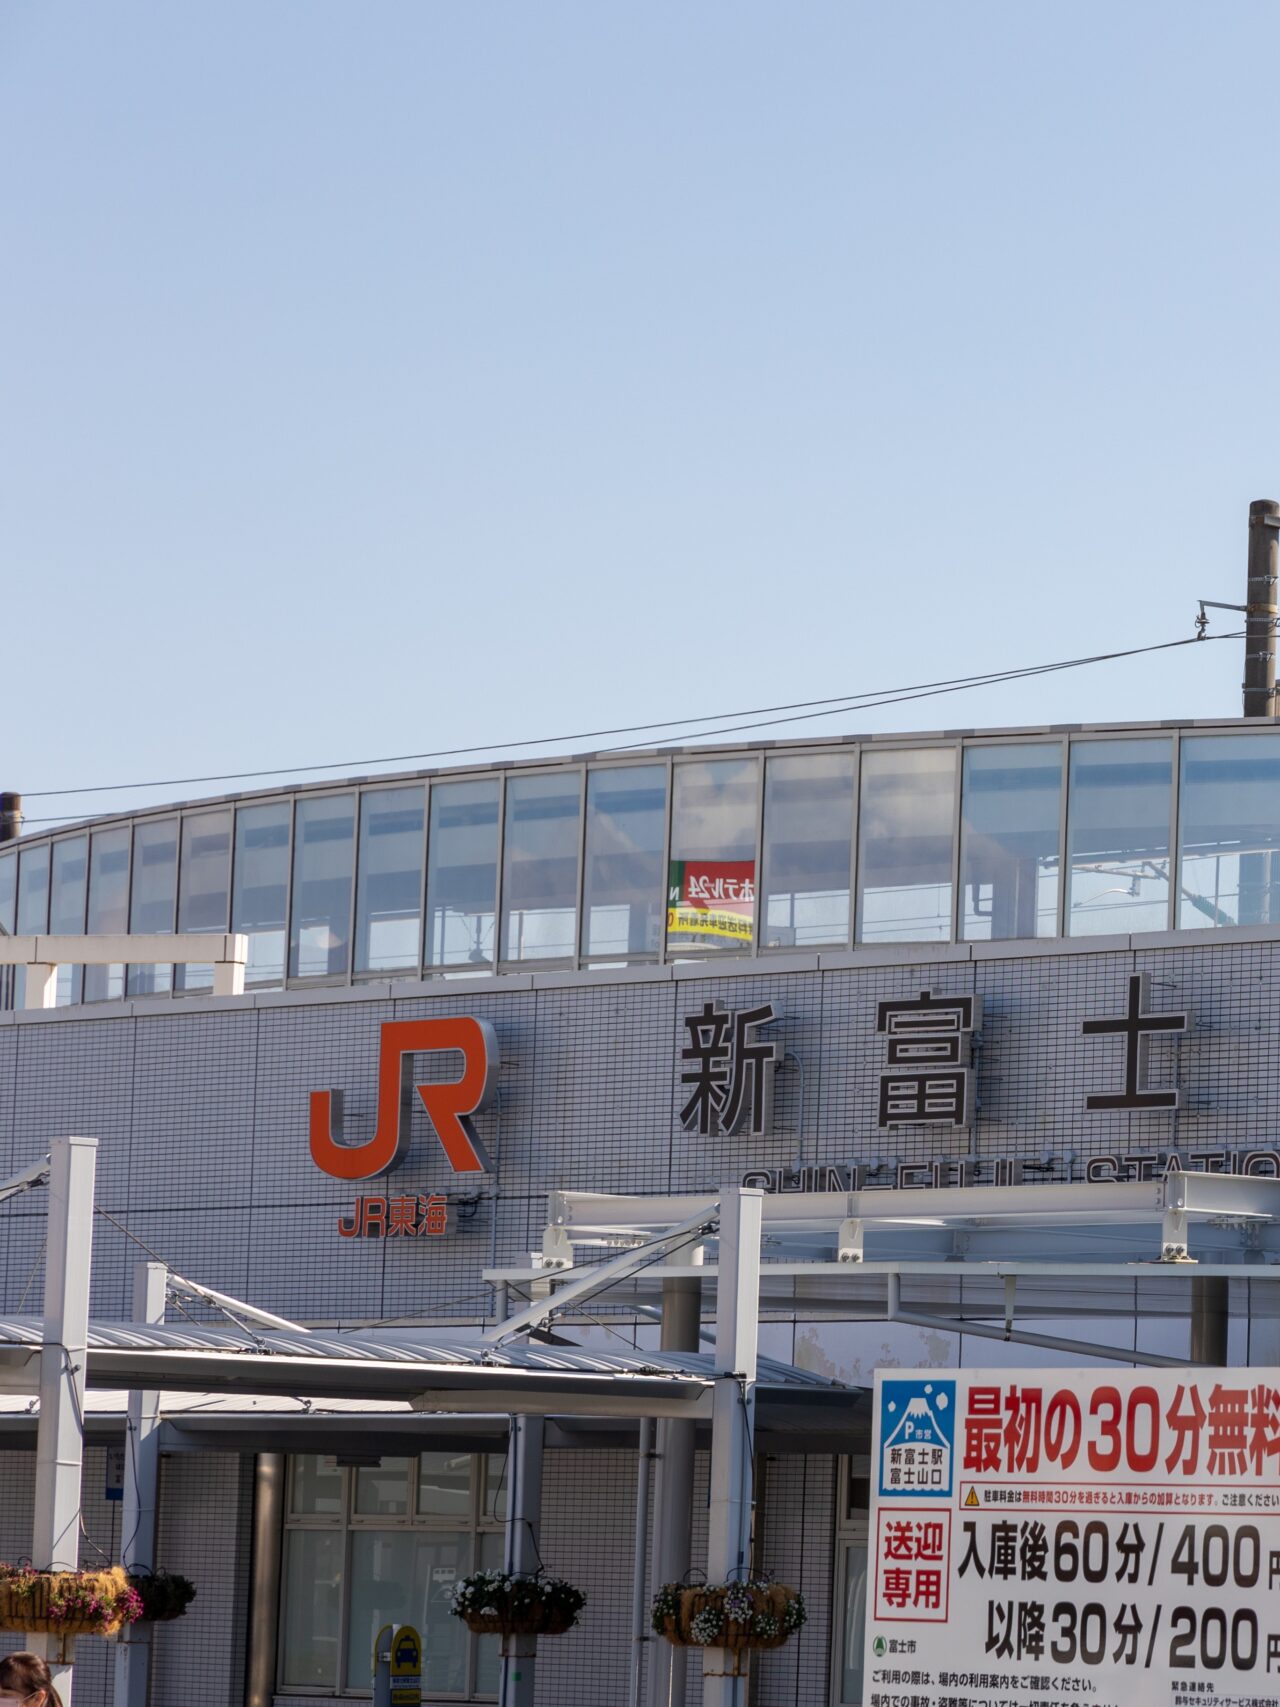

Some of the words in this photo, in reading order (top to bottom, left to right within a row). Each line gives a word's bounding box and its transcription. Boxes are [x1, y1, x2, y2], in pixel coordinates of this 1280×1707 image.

[309, 1016, 492, 1180] JR
[337, 1194, 448, 1237] JR東海
[890, 1448, 943, 1465] 新富士駅
[890, 1467, 942, 1485] 富士山口
[883, 1521, 944, 1564] 送迎
[883, 1567, 942, 1610] 専用
[888, 1638, 917, 1655] 富士市
[872, 1668, 1098, 1693] ご利用の際は、場内の利用案内をご確認ください。
[1171, 1680, 1215, 1693] 緊急連絡先
